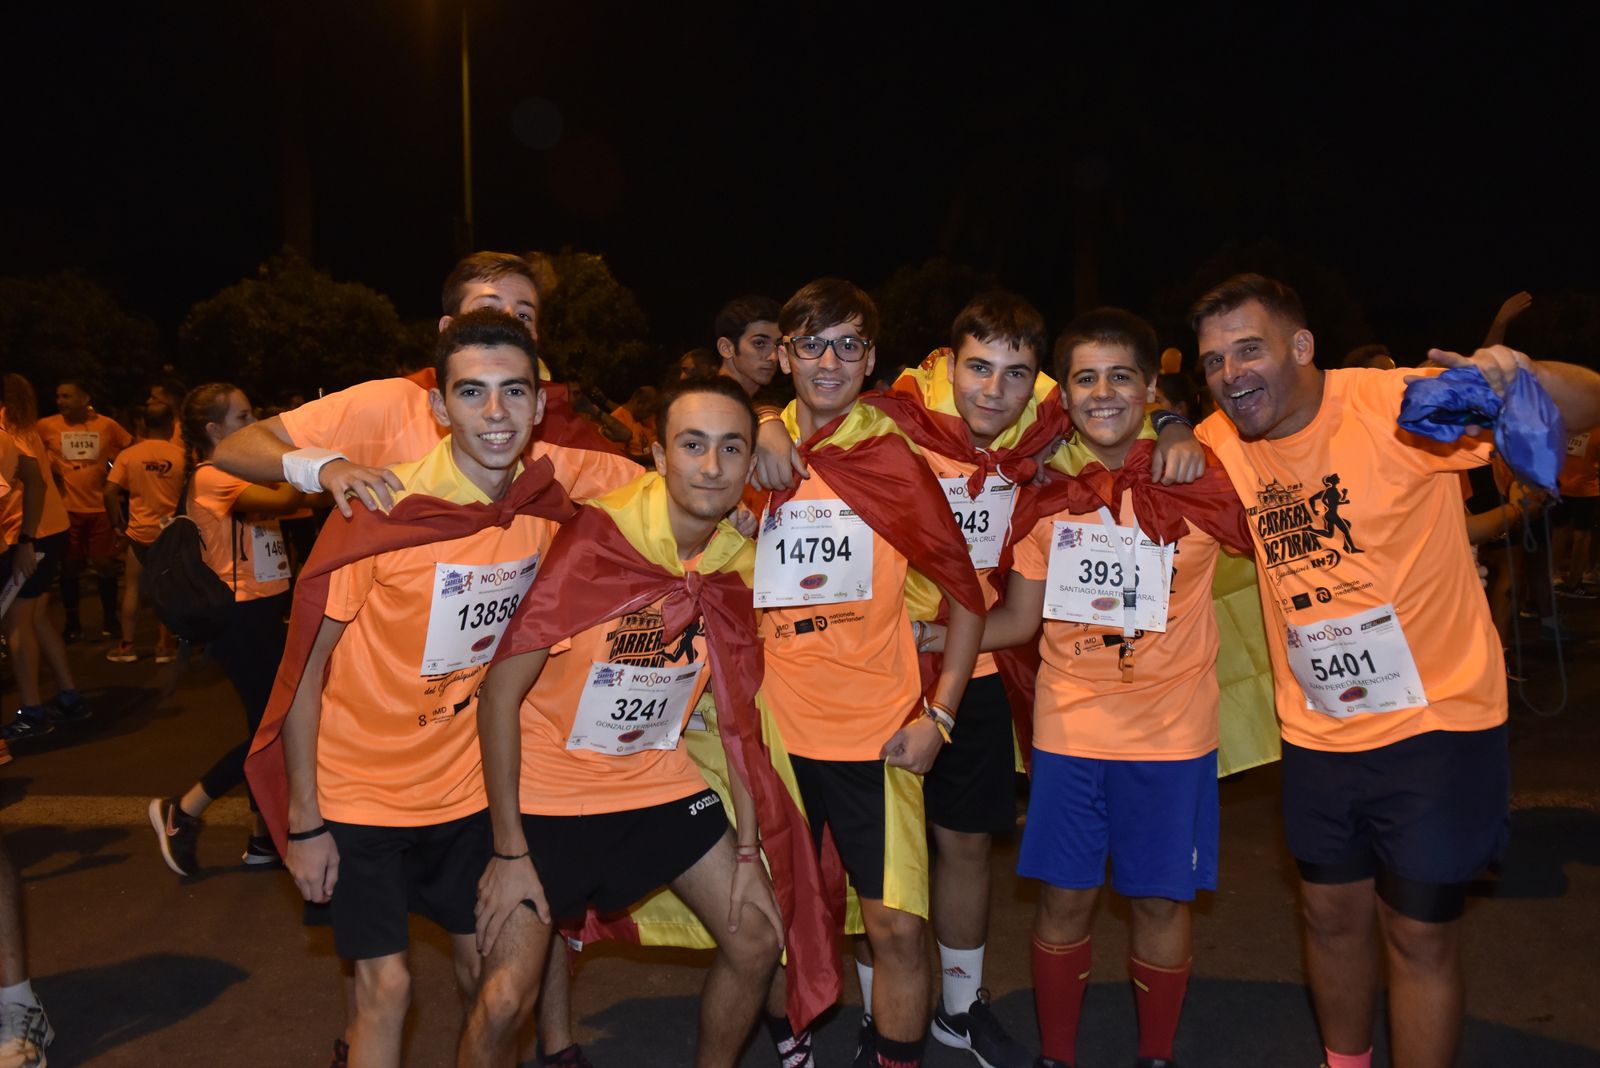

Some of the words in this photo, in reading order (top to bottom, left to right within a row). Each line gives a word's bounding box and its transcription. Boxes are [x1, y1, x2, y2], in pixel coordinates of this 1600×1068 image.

[775, 535, 852, 565] 14794
[1059, 585, 1097, 596] SANTIAGO
[457, 593, 520, 631] 13858
[1310, 649, 1377, 682] 5401
[610, 698, 669, 721] 3241
[595, 720, 632, 731] GONZALO
